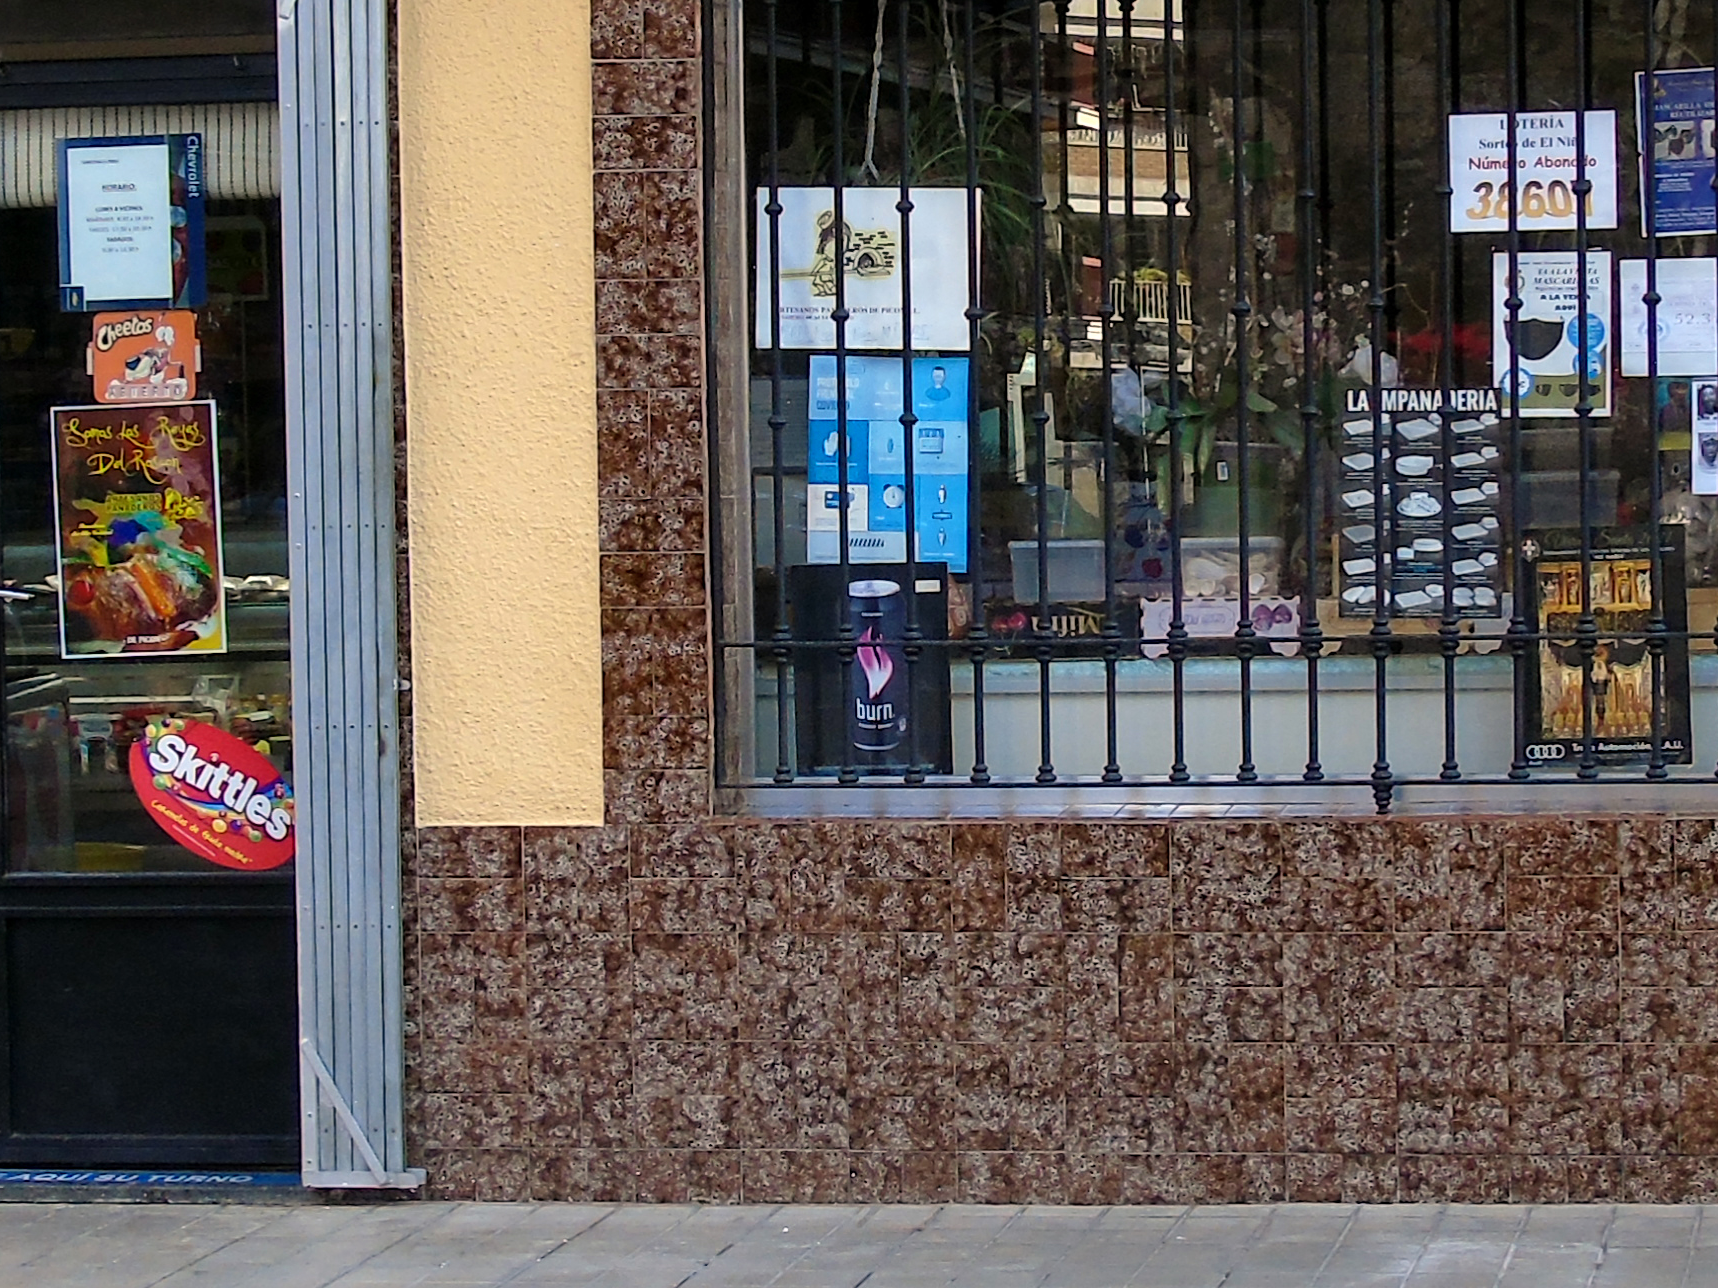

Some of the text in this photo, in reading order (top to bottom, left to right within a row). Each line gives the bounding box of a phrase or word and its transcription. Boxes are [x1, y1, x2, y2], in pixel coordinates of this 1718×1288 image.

[1478, 137, 1519, 150] Sorte
[1521, 137, 1537, 149] de
[1539, 136, 1554, 148] El
[185, 135, 201, 198] Chevrolet
[1468, 155, 1527, 171] Númeo
[1533, 276, 1601, 285] MASCARIAS
[775, 306, 820, 314] RTESANOS
[96, 316, 154, 352] Cheetos
[1346, 389, 1370, 412] LA
[856, 696, 894, 722] burn
[149, 733, 292, 841] Skittles
